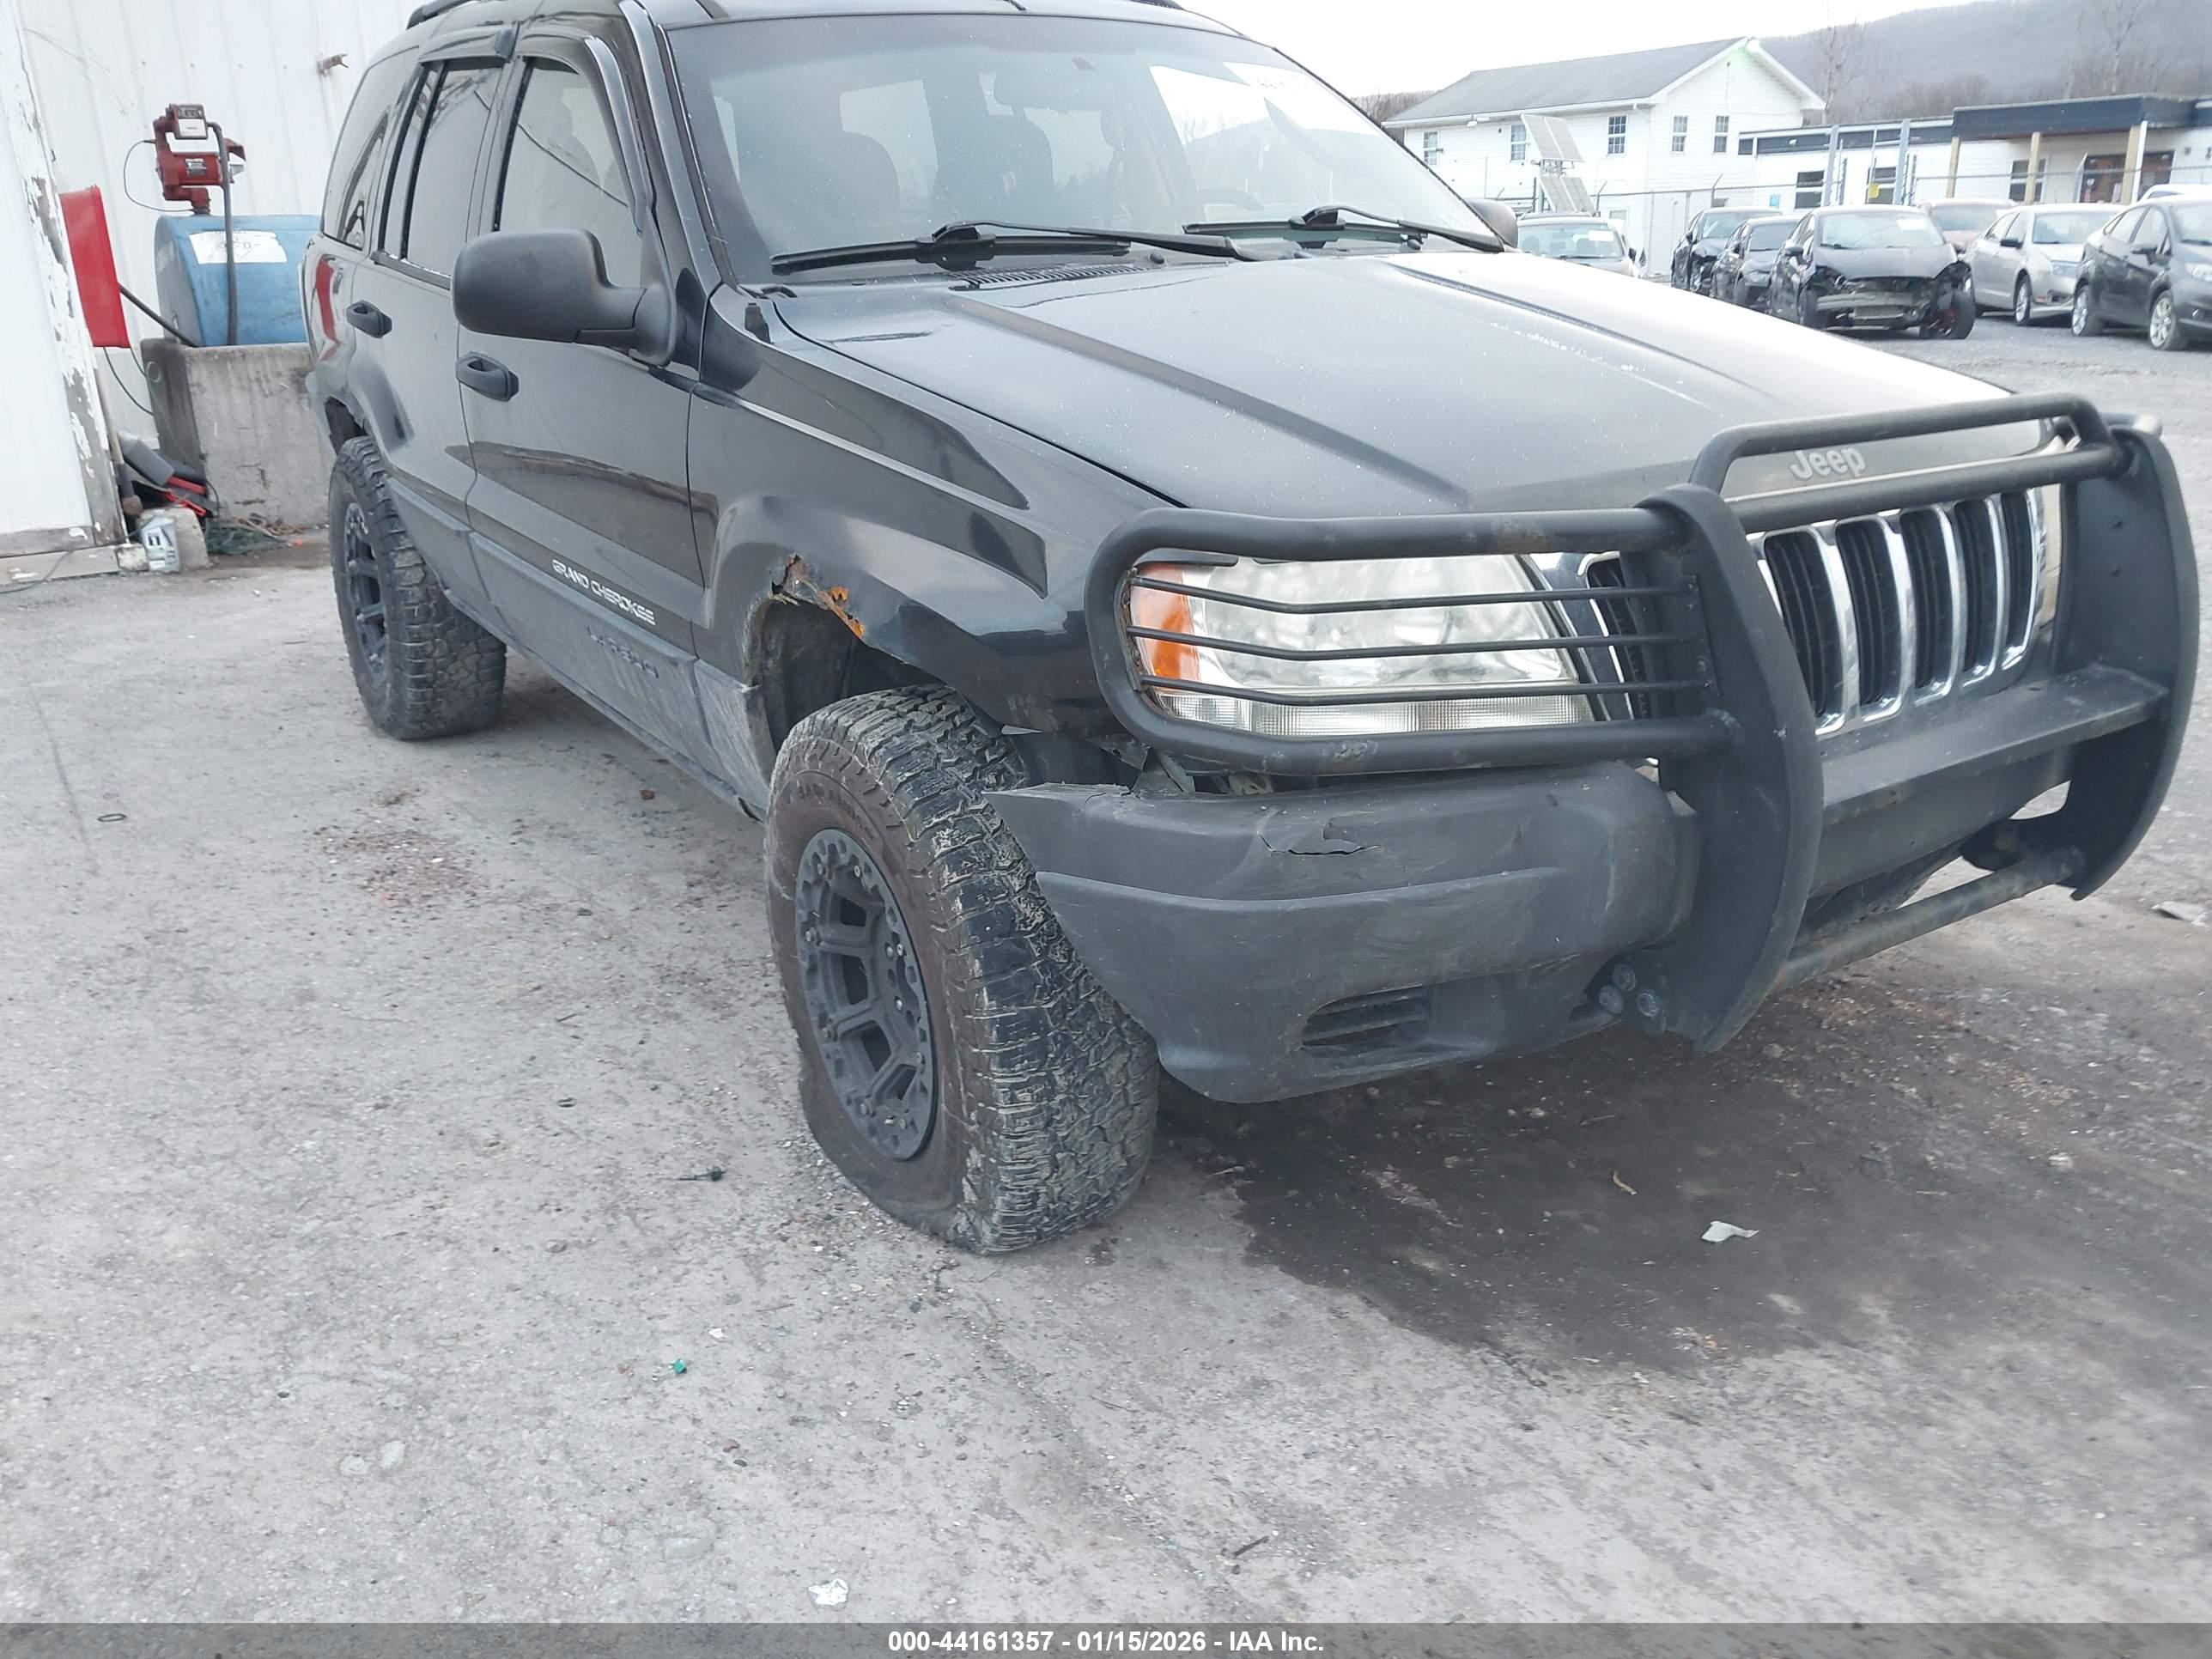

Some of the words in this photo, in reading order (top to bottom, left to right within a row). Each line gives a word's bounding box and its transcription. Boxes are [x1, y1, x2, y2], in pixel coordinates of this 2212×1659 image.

[1789, 447, 1866, 479] Jeep
[552, 559, 590, 590] GRAND
[590, 580, 656, 626] CHEROKEE
